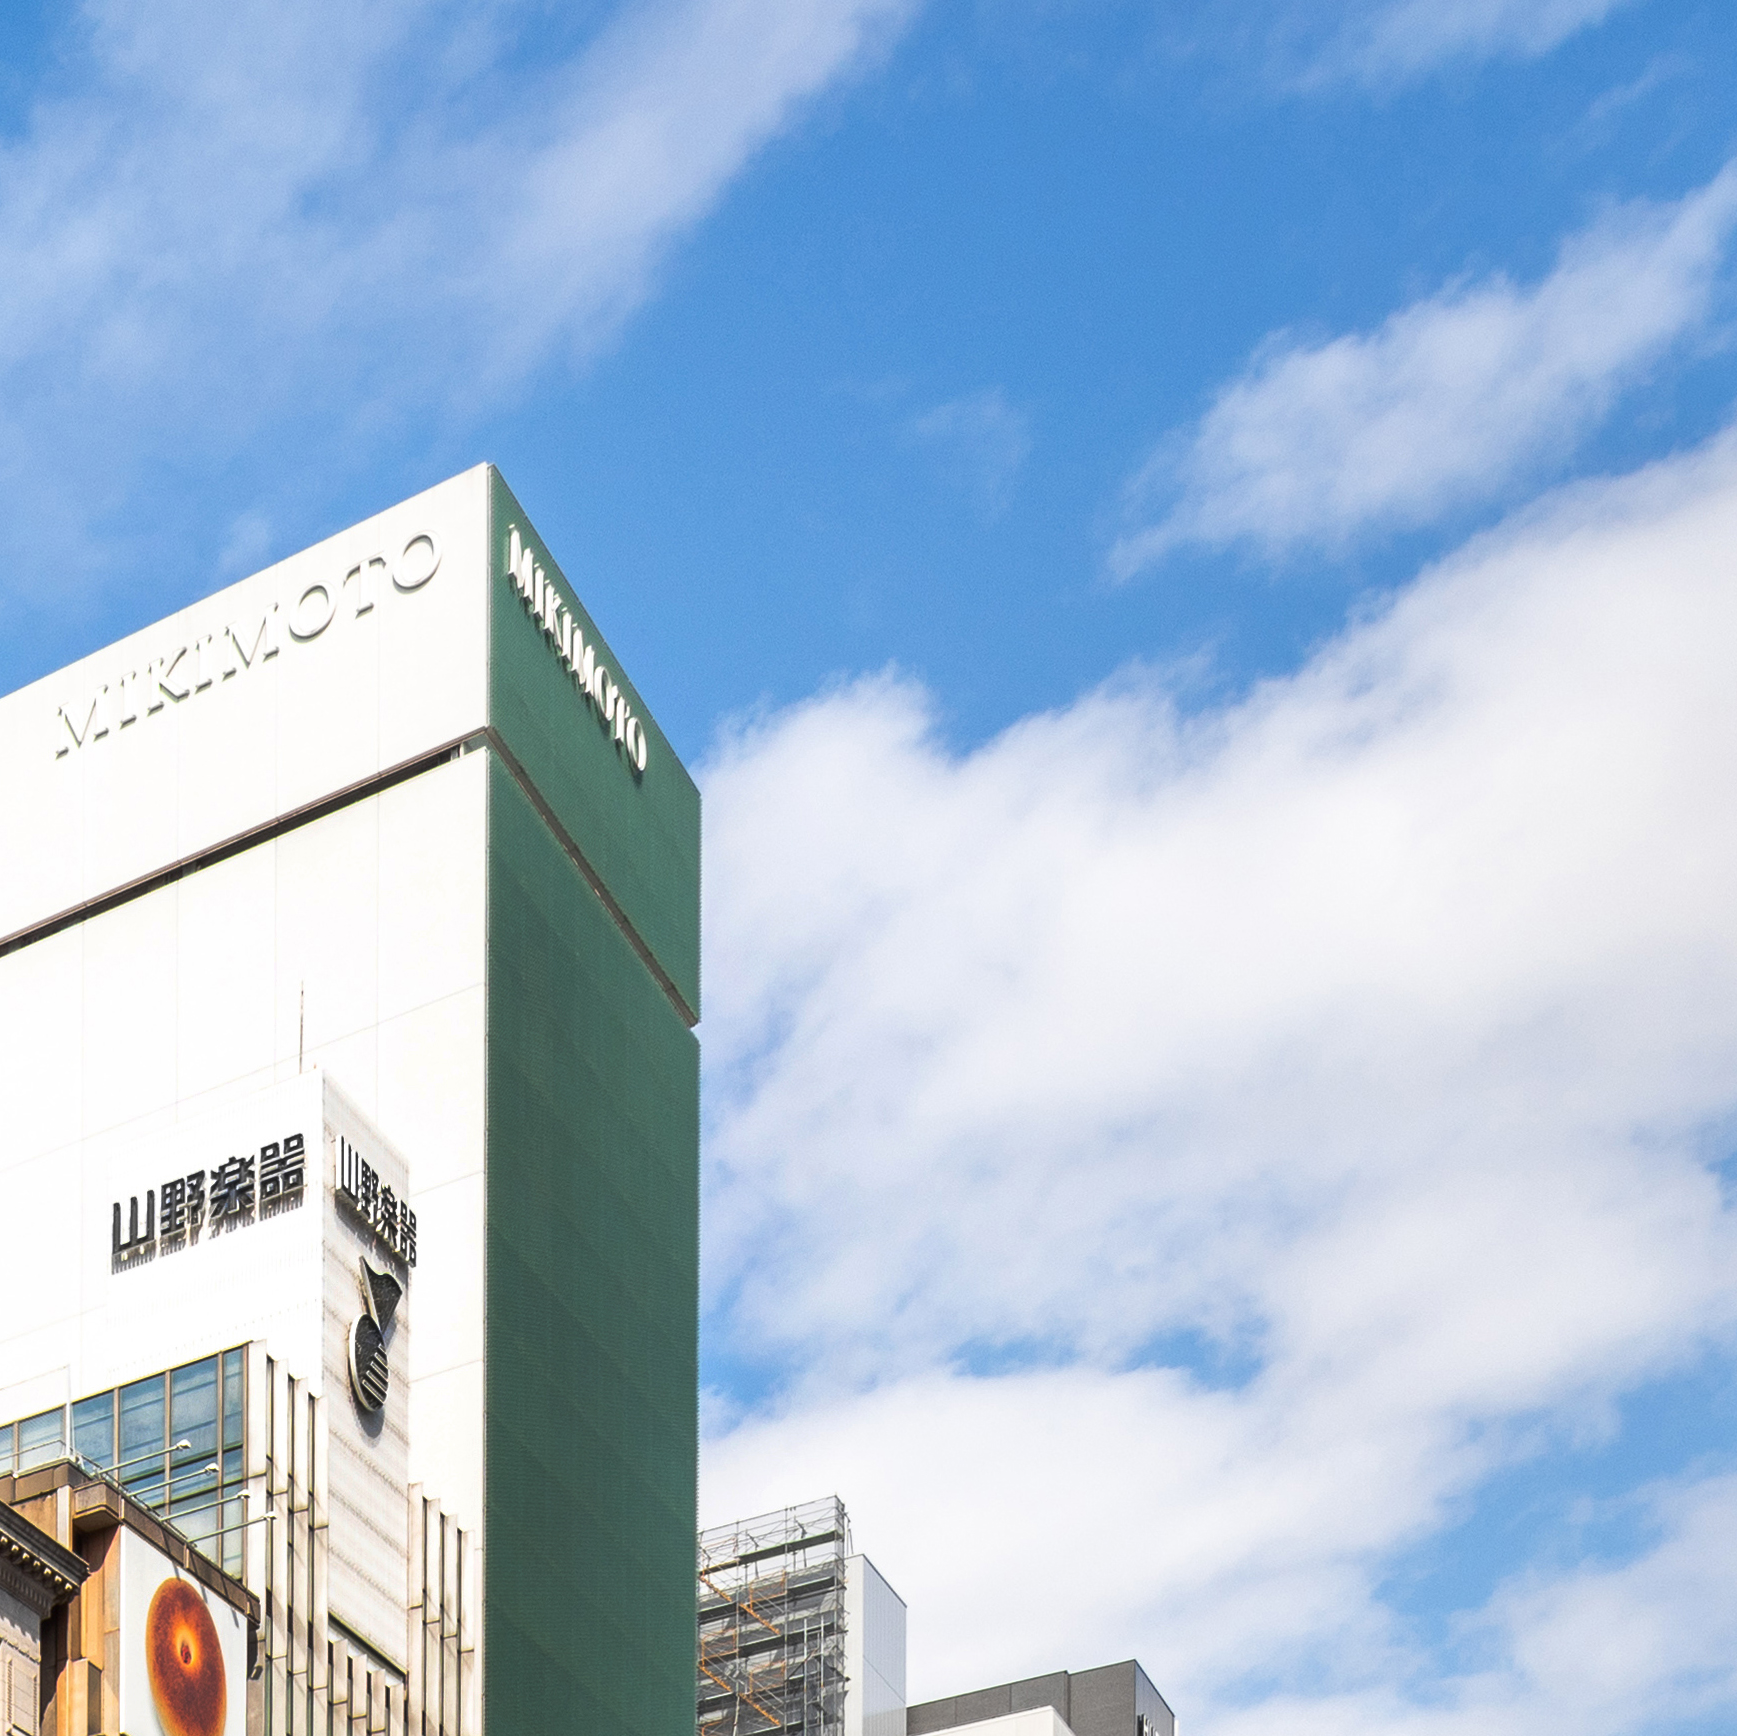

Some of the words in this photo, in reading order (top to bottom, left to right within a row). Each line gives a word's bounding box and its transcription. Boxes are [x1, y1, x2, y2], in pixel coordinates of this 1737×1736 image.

[56, 530, 444, 760] MIKIMOTO
[507, 524, 647, 773] MIKIMOTO
[112, 1133, 304, 1270] 山野楽器
[336, 1135, 417, 1268] 山野楽器
